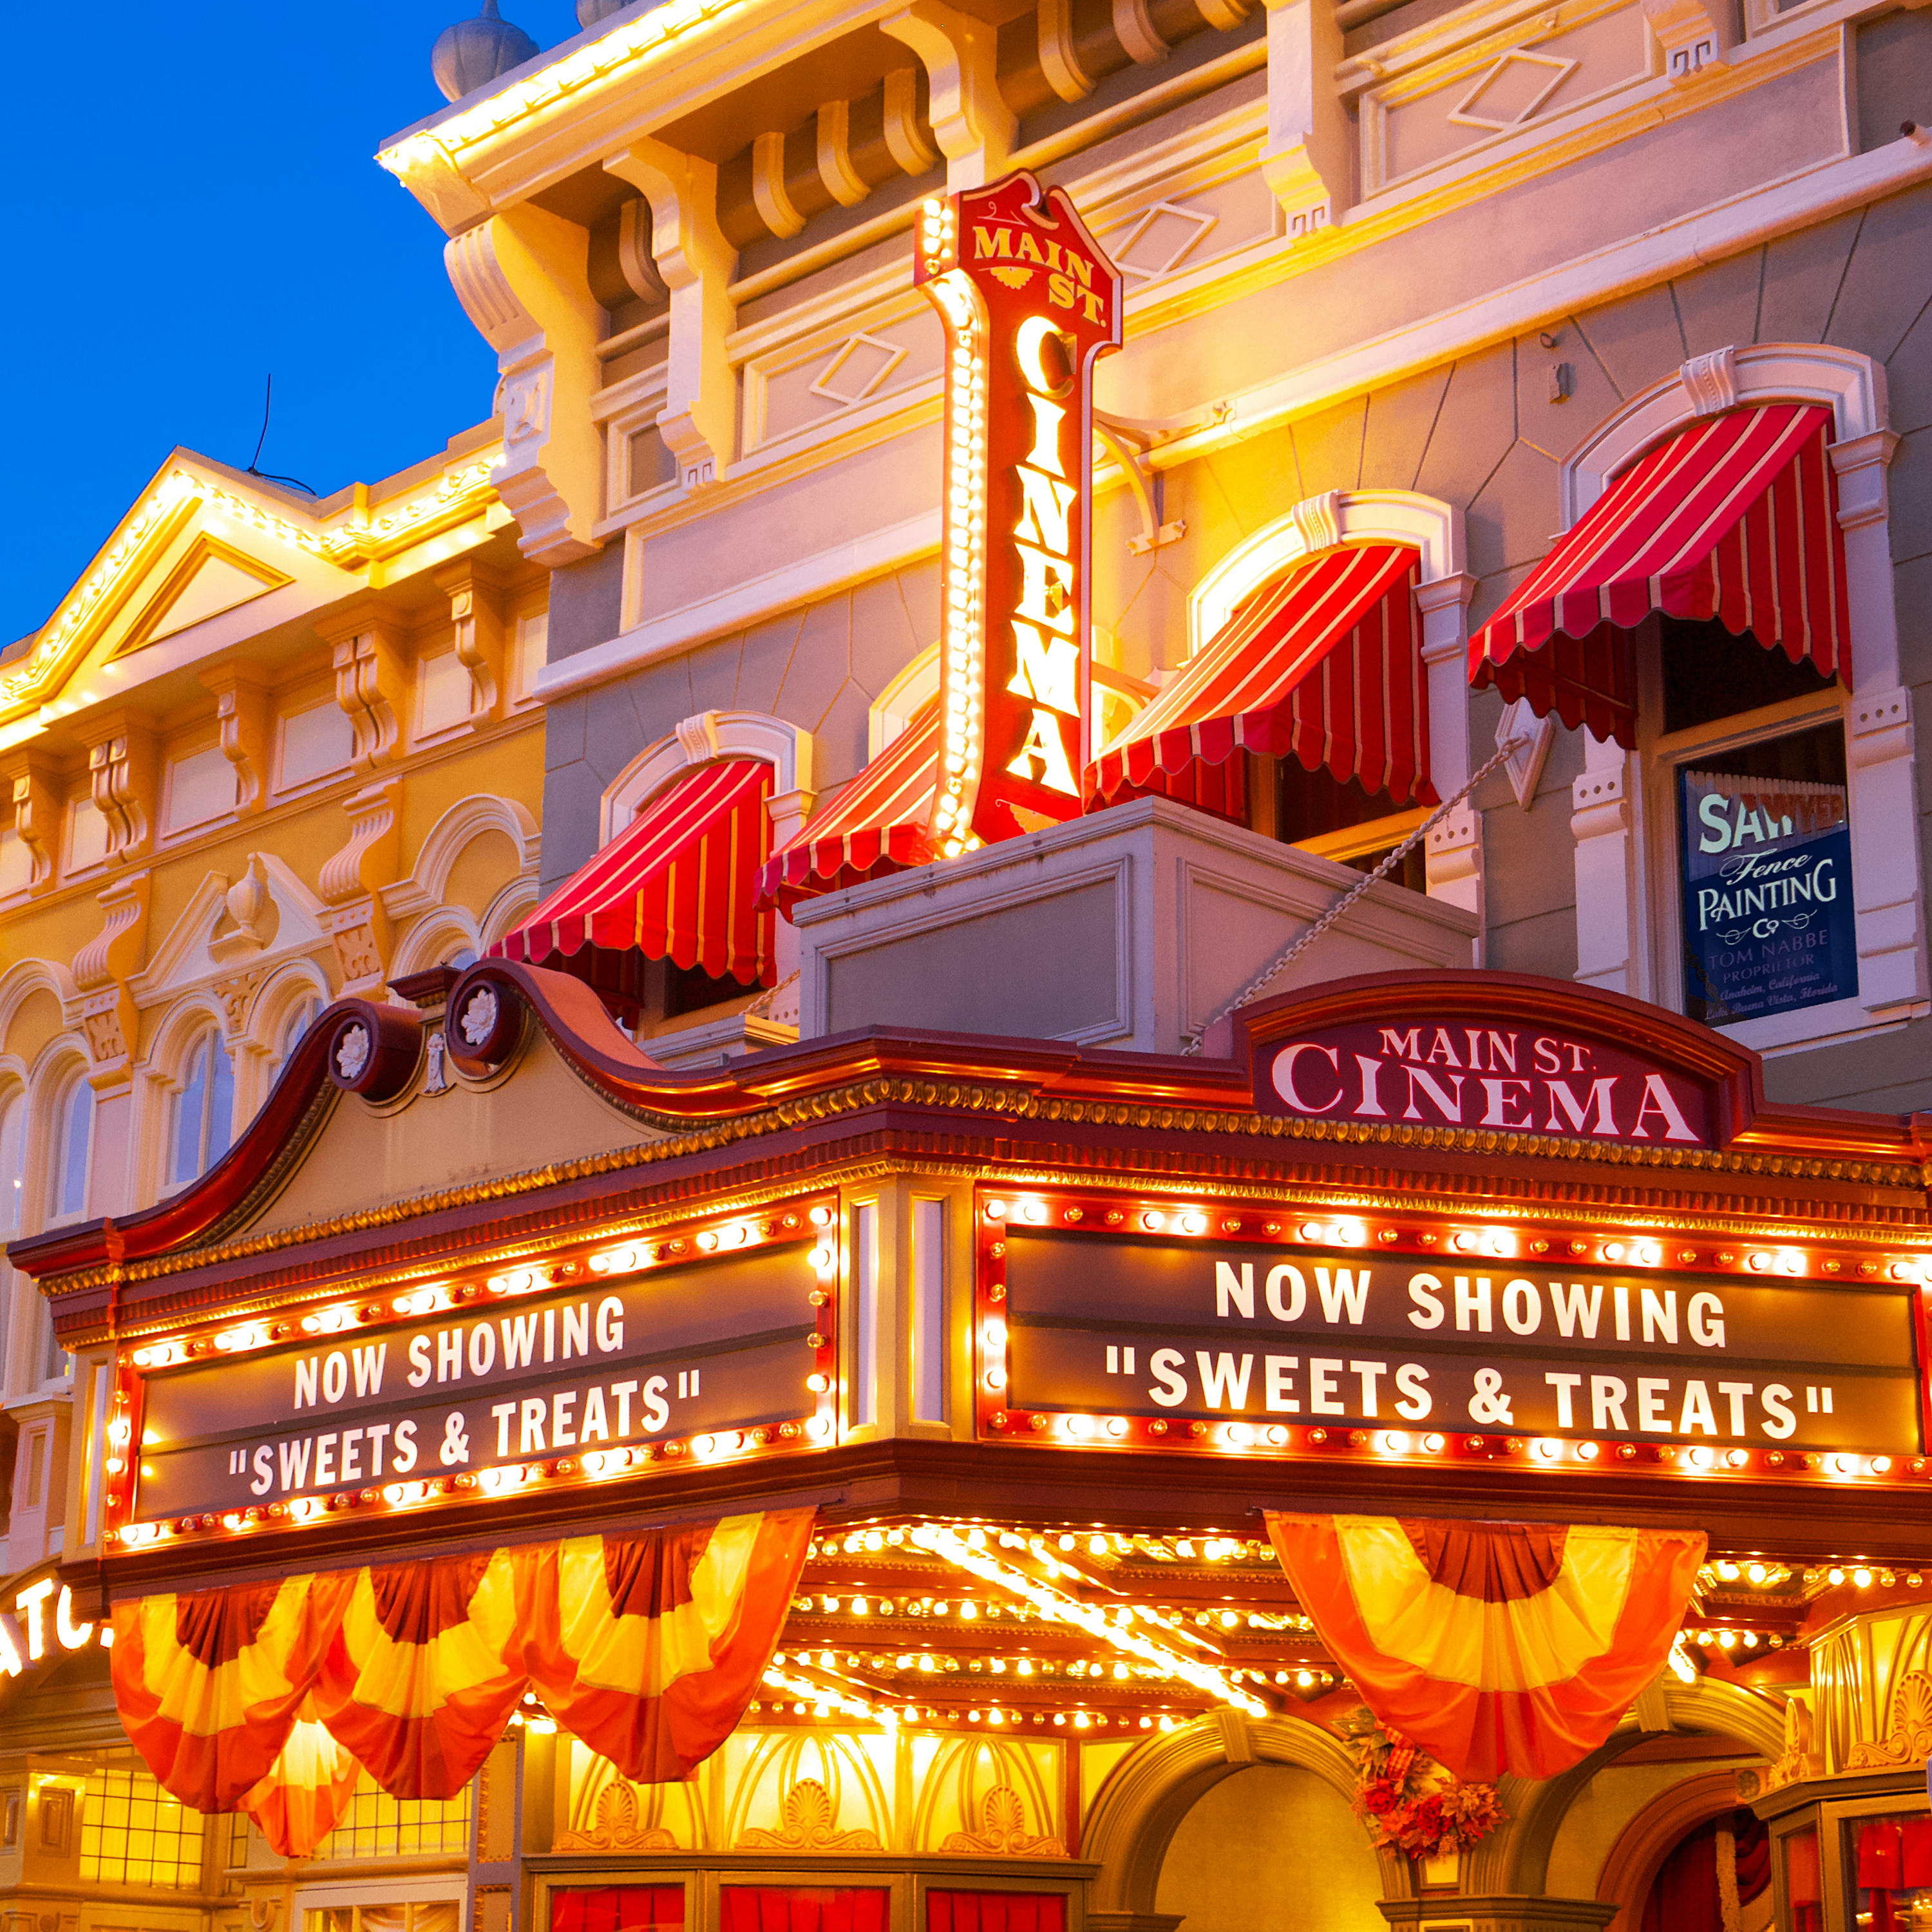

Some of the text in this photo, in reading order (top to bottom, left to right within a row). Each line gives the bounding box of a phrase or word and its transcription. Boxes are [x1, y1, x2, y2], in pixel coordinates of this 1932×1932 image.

[973, 226, 1094, 288] MAIN
[1049, 273, 1106, 328] ST.
[1005, 316, 1081, 799] CINEMA
[1698, 858, 1837, 931] PAINTING
[1719, 848, 1812, 885] Fence
[1709, 929, 1828, 970] TOM NABBE
[1723, 954, 1814, 984] PROPRIETOR
[1768, 972, 1820, 990] California
[1378, 1028, 1597, 1074] MAIN ST.
[1271, 1043, 1704, 1143] CINEMA
[1215, 1260, 1726, 1349] NOW SHOWING
[294, 1296, 625, 1409] NOW SHOWING
[1105, 1345, 1833, 1441] "SWEETS & TREATS"
[229, 1369, 700, 1496] "SWEETS & TREATS"
